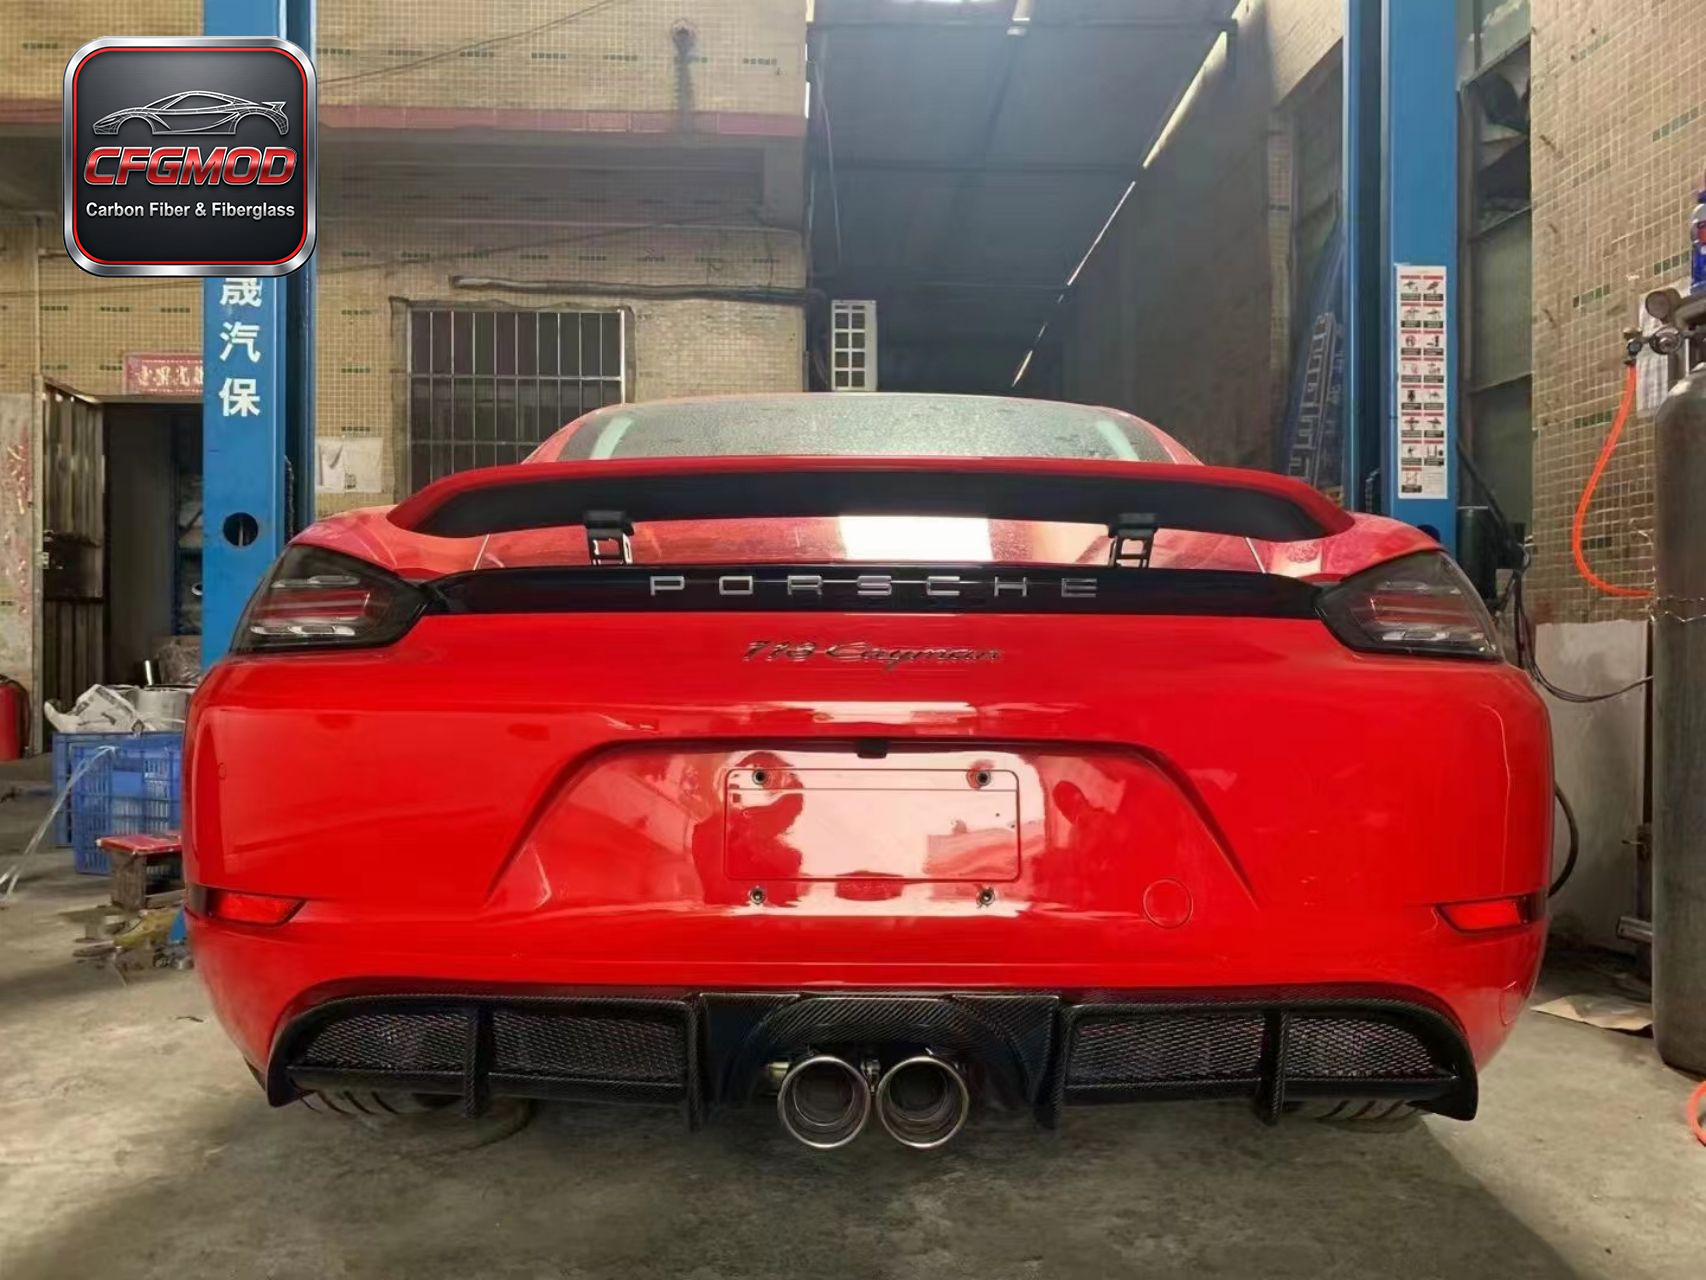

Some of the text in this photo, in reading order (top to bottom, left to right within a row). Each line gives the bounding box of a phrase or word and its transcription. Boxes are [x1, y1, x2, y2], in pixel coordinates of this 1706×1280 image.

[649, 575, 1098, 598] PORSCHE
[743, 640, 999, 672] 718 Cayman
